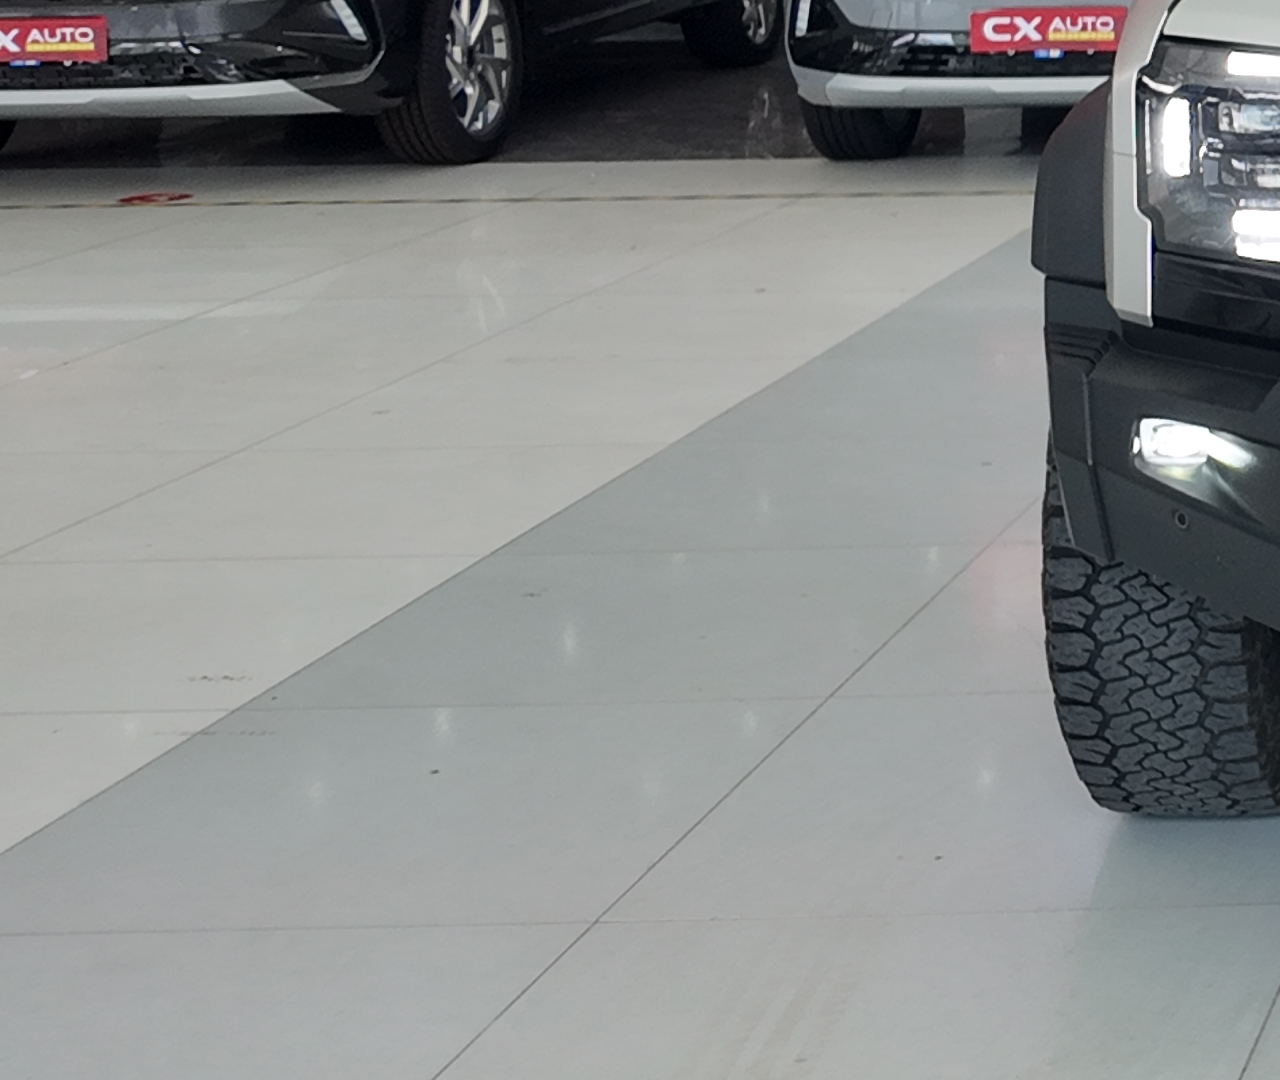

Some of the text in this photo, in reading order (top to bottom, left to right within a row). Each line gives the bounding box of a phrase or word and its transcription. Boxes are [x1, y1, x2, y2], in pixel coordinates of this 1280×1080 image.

[26, 26, 95, 43] AUTO
[983, 15, 1115, 43] CX AUTO
